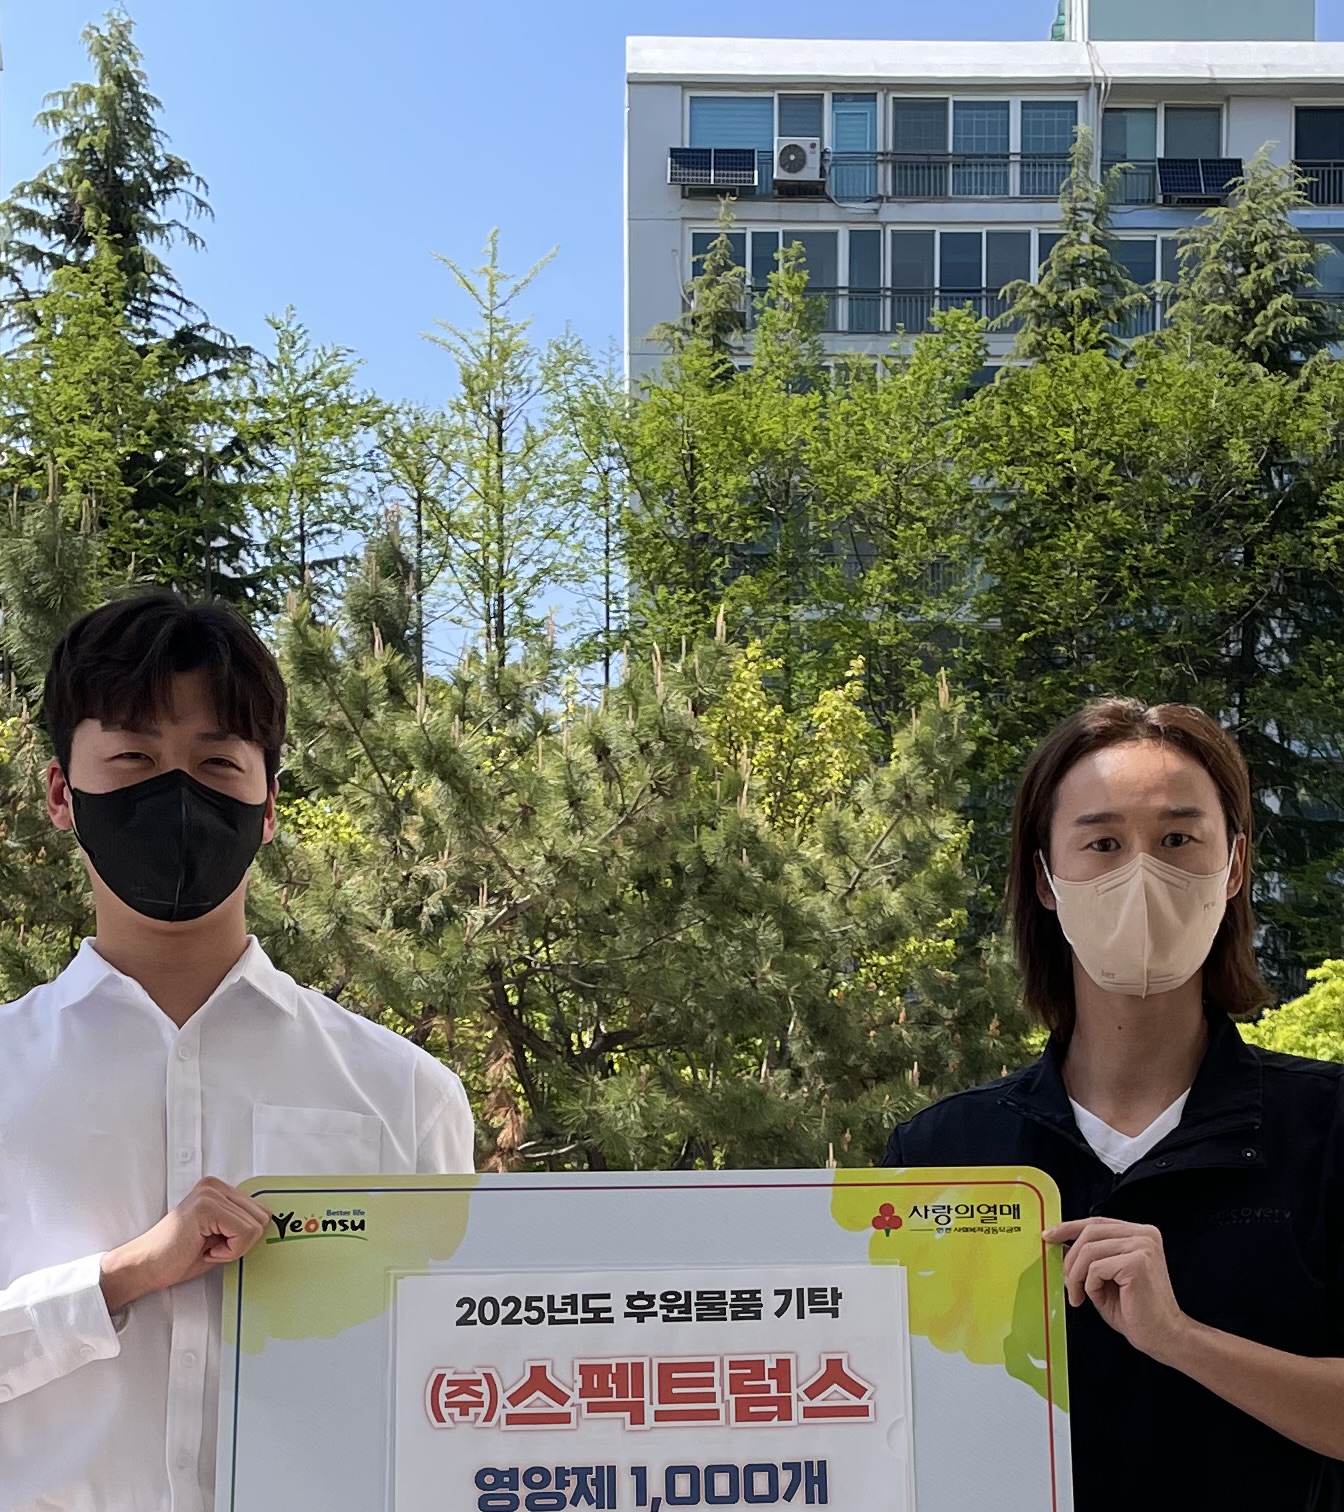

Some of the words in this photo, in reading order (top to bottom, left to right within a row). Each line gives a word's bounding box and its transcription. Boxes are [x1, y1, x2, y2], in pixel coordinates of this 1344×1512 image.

[271, 1211, 366, 1240] Yeonsu
[908, 1203, 1021, 1226] 사랑의열매
[456, 1293, 614, 1326] 2025년도
[624, 1289, 763, 1323] 후원물품
[774, 1287, 842, 1319] 기탁
[475, 1465, 616, 1512] 영양제
[631, 1460, 828, 1512] 1,000개
